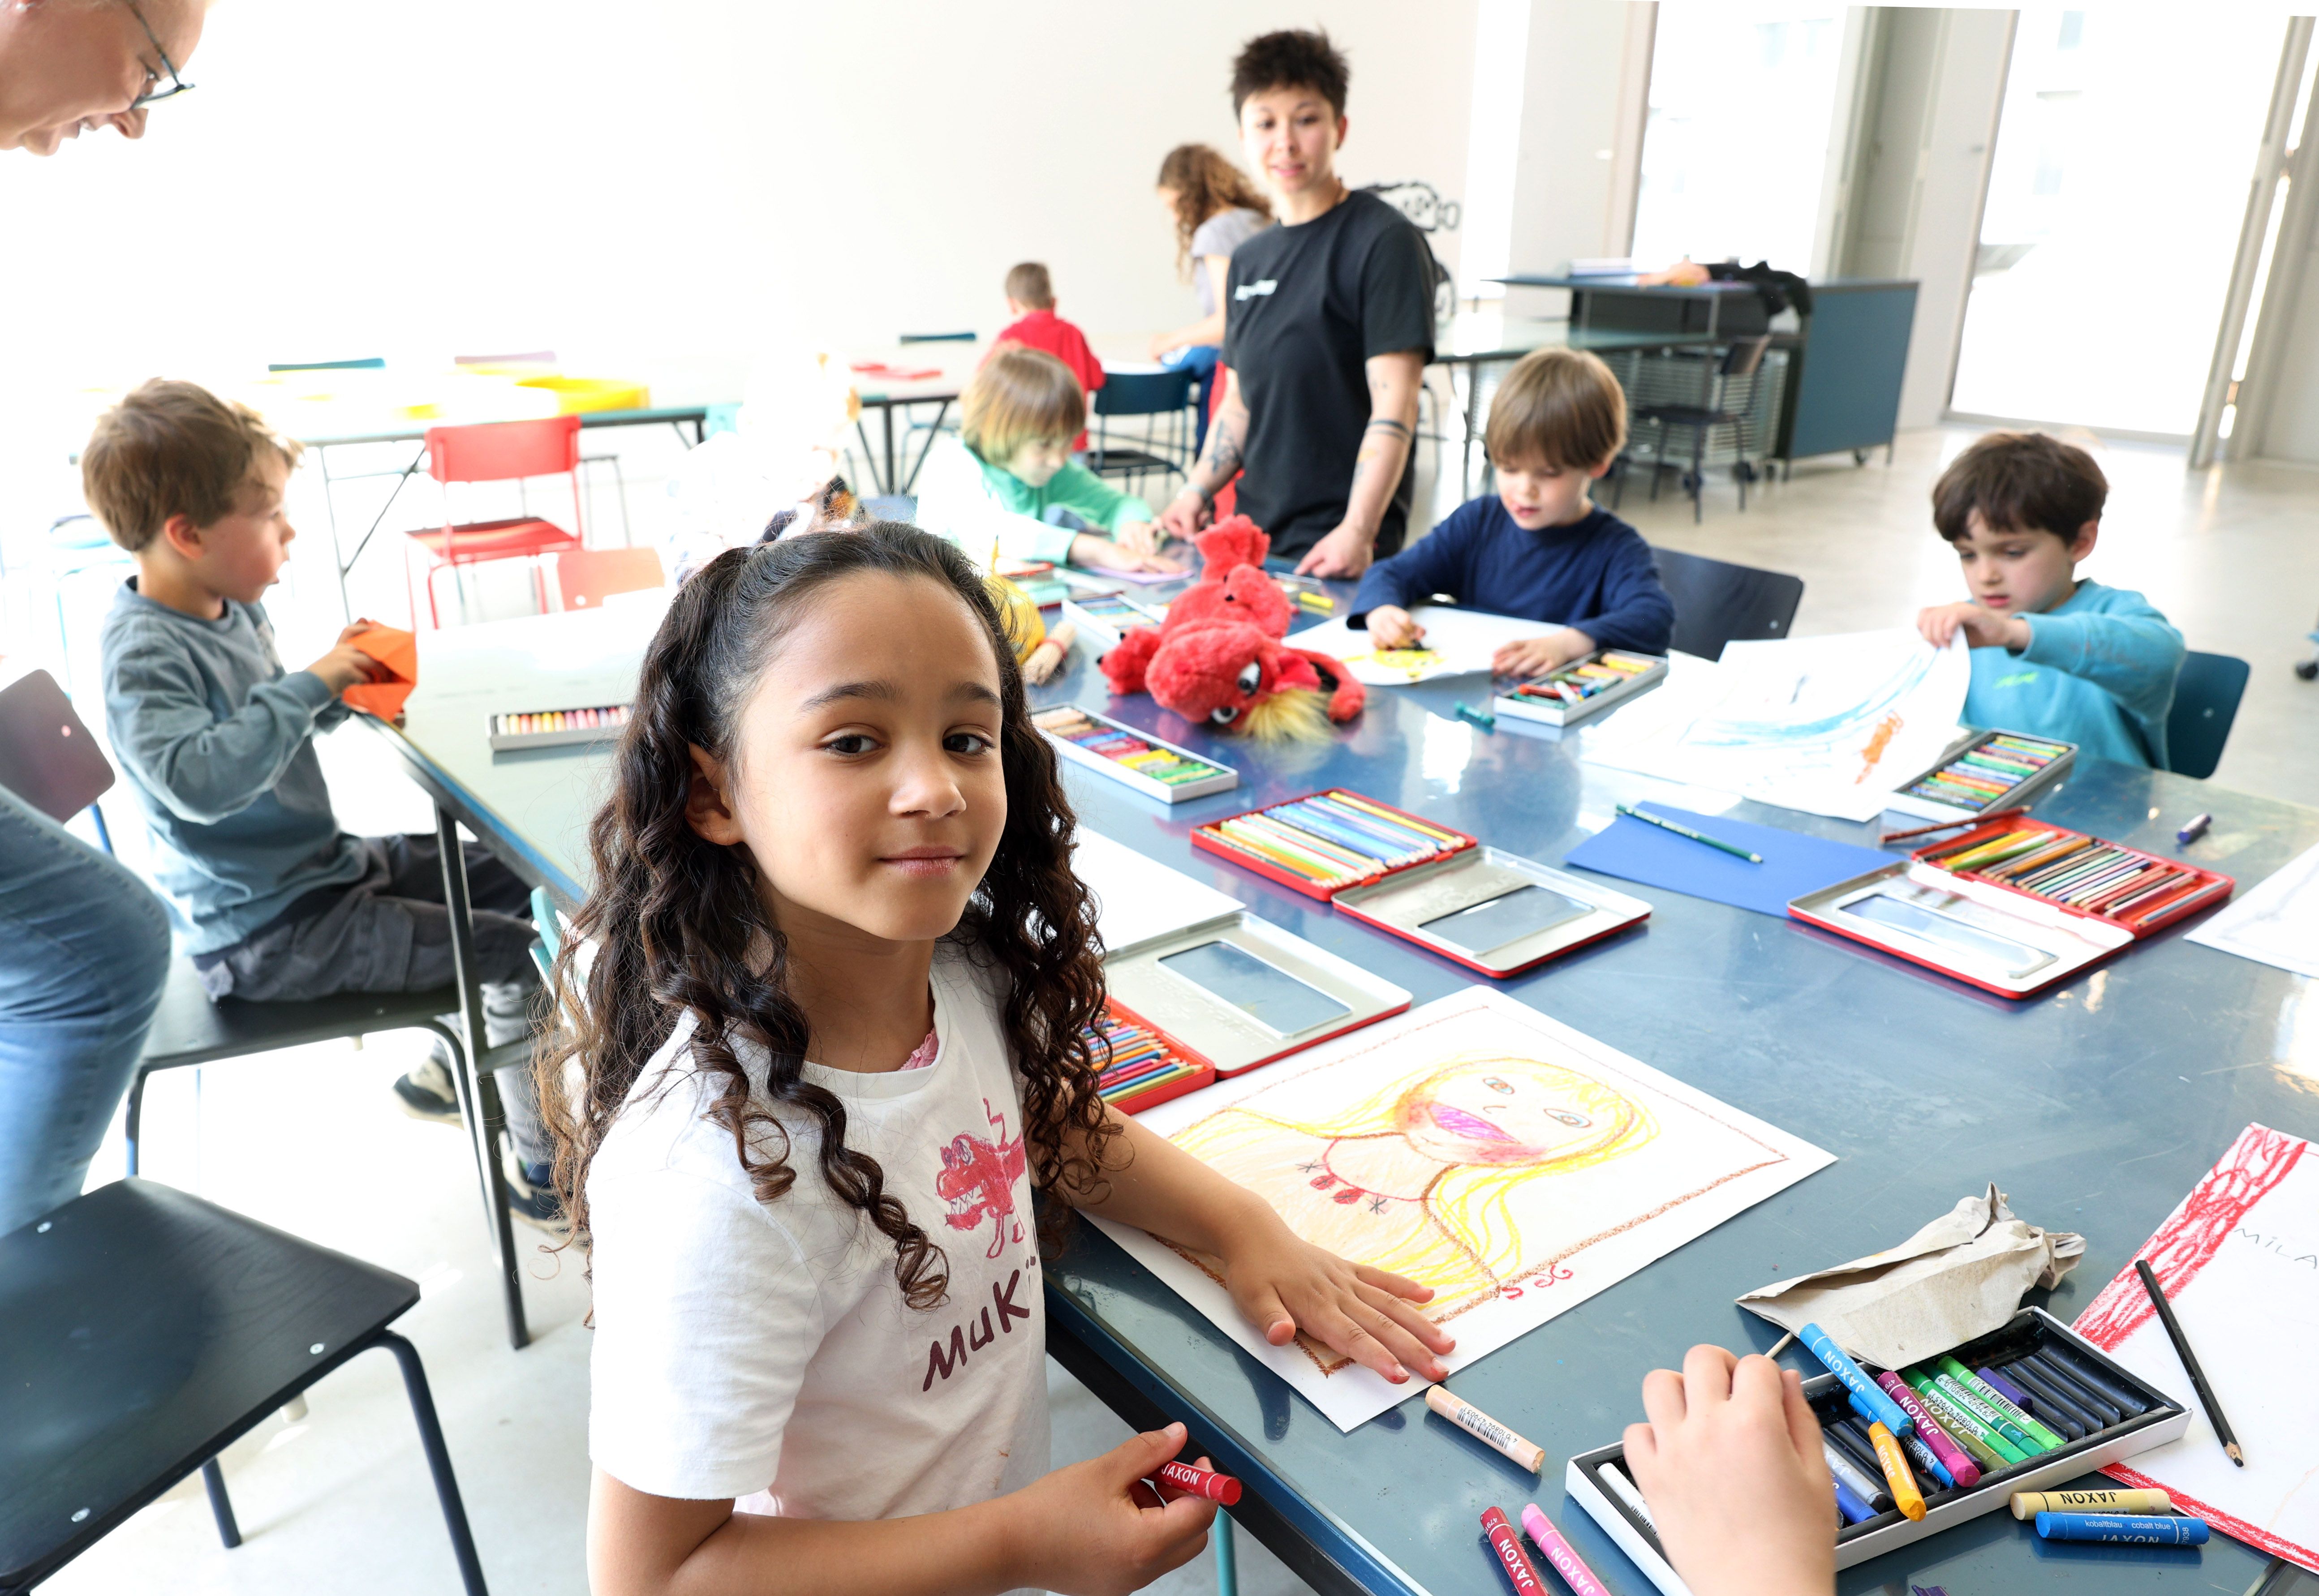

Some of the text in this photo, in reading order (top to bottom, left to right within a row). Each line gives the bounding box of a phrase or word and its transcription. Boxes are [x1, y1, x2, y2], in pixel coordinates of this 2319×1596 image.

[923, 1269, 1030, 1392] MuK
[1824, 1350, 1865, 1393] JAXON
[1899, 1395, 1939, 1435] JAXON
[1931, 1394, 1953, 1412] 479451
[1944, 1381, 1966, 1401] 010894
[1968, 1400, 1992, 1419] 479482
[1463, 1407, 1486, 1424] 479031
[1489, 1422, 1511, 1439] 010894
[1920, 1398, 1970, 1435] JAXON
[1956, 1412, 1978, 1433] 010894
[1161, 1463, 1201, 1485] JAXON
[1824, 1450, 1851, 1476] JAX
[1877, 1445, 1896, 1480] JAXON
[2060, 1492, 2117, 1504] JAXON
[2084, 1519, 2171, 1530] kobaltblau cobalt blue
[1499, 1538, 1534, 1588] JAXON
[1550, 1547, 1595, 1596] JAXON
